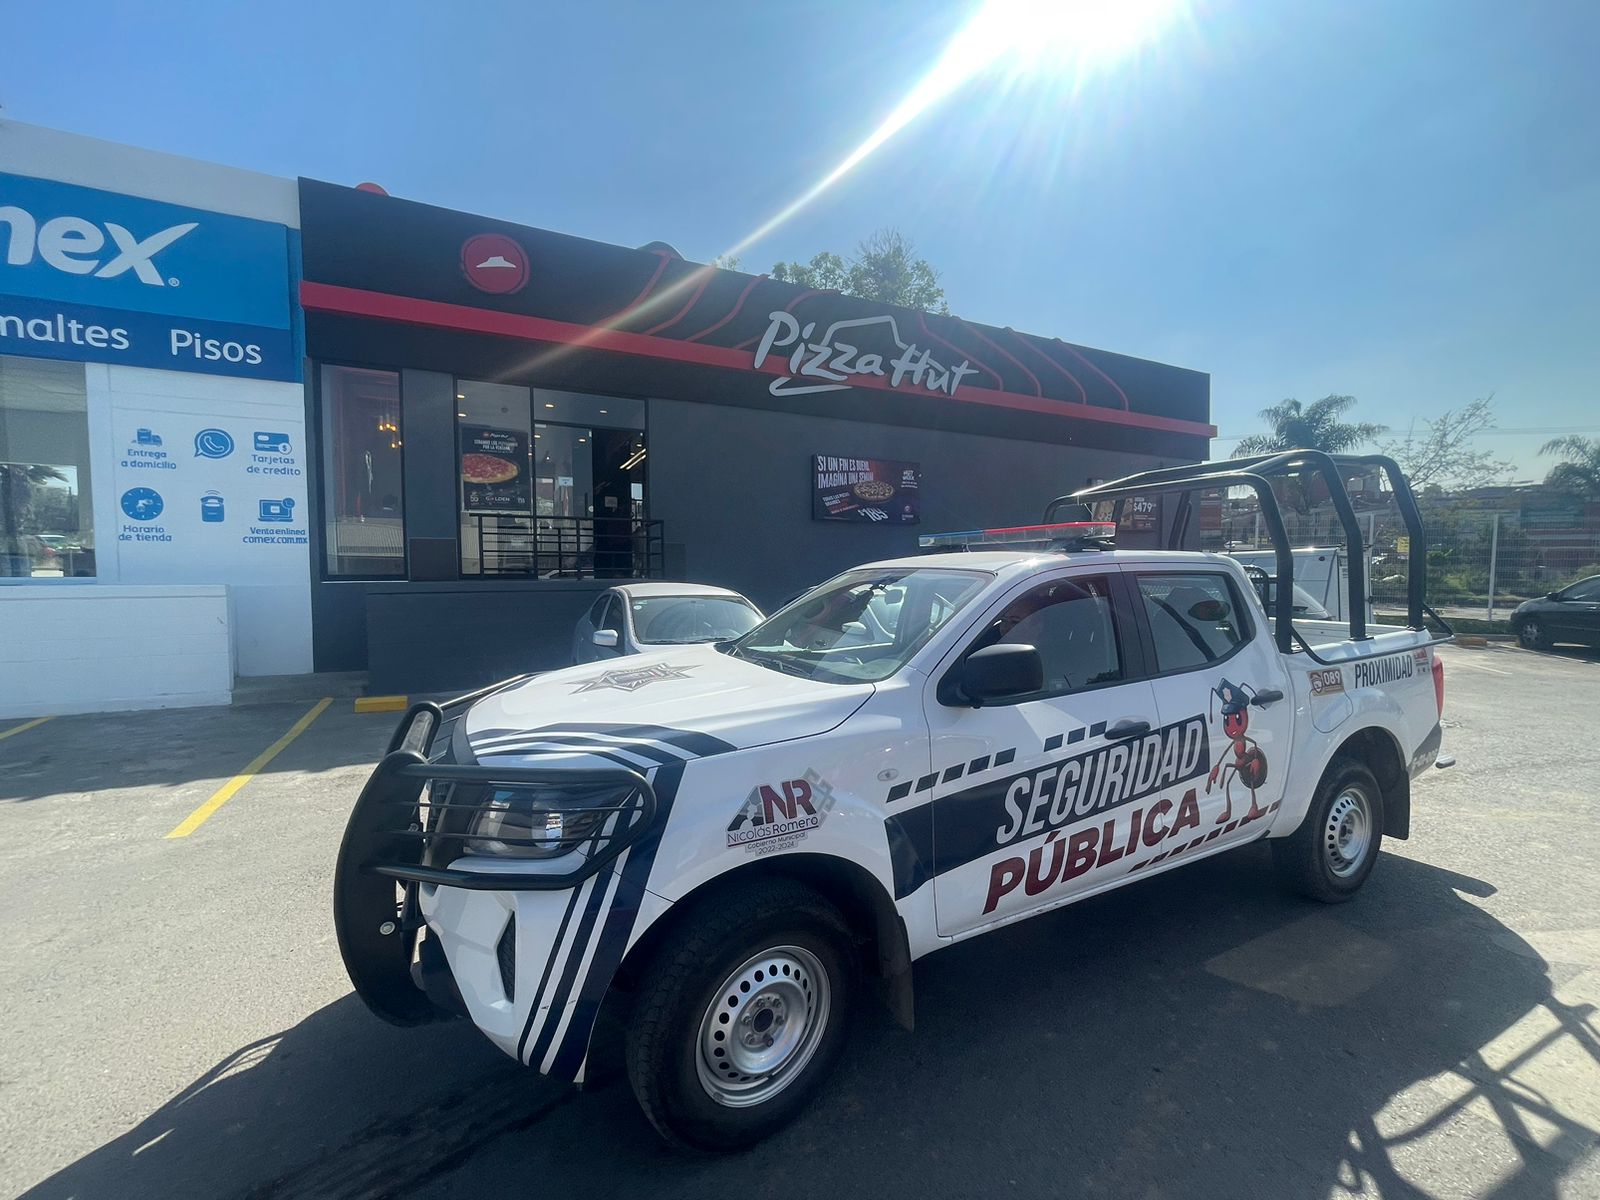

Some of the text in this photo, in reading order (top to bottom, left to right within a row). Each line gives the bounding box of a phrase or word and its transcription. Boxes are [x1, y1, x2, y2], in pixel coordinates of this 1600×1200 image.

[170, 328, 263, 365] Pisos
[754, 311, 979, 396] Pizza Hut
[127, 448, 167, 459] Entrega
[251, 454, 295, 465] Tarjetas
[130, 460, 177, 470] domicilio
[246, 466, 260, 474] de
[817, 455, 826, 471] SI
[827, 456, 838, 471] UN
[123, 525, 165, 533] Horario
[118, 533, 172, 542] de tienda
[1323, 671, 1340, 685] 089
[1354, 655, 1413, 689] PROXIMIDAD
[996, 719, 1203, 845] SEGURIDAD
[727, 815, 819, 844] Nicolás Romero
[777, 831, 806, 843] Municipal
[758, 841, 795, 855] 2022-2024
[982, 788, 1201, 915] PÚBLICA
